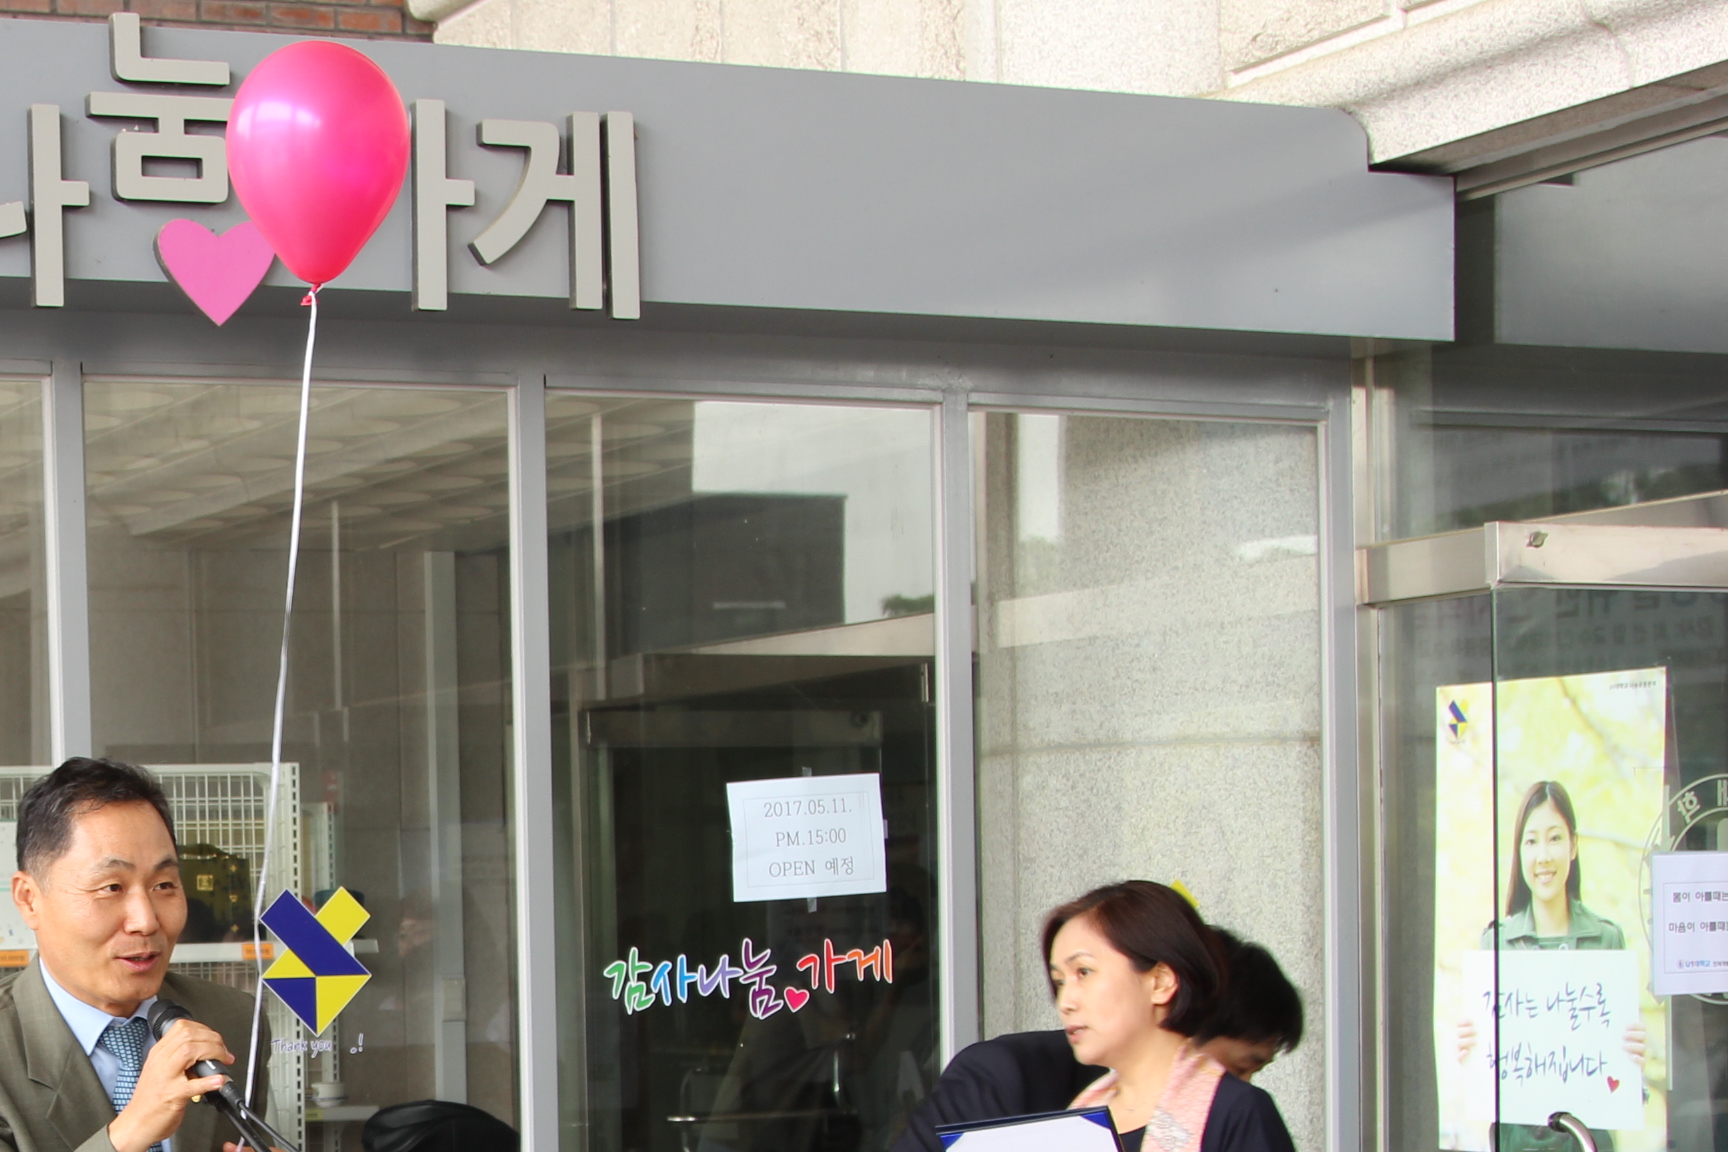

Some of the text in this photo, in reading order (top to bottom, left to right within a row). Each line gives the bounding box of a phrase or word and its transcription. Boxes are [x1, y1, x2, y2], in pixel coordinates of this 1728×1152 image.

[763, 797, 853, 818] 2017.05.11.
[775, 827, 847, 848] PM.15:00
[768, 856, 854, 878] OPEN 예정
[603, 937, 894, 1020] 감사나눔 가게
[1482, 981, 1612, 1032] 감사는 나눌수록
[271, 1037, 309, 1054] Thank
[310, 1038, 333, 1059] you
[1485, 1041, 1609, 1087] 행복해집니다
